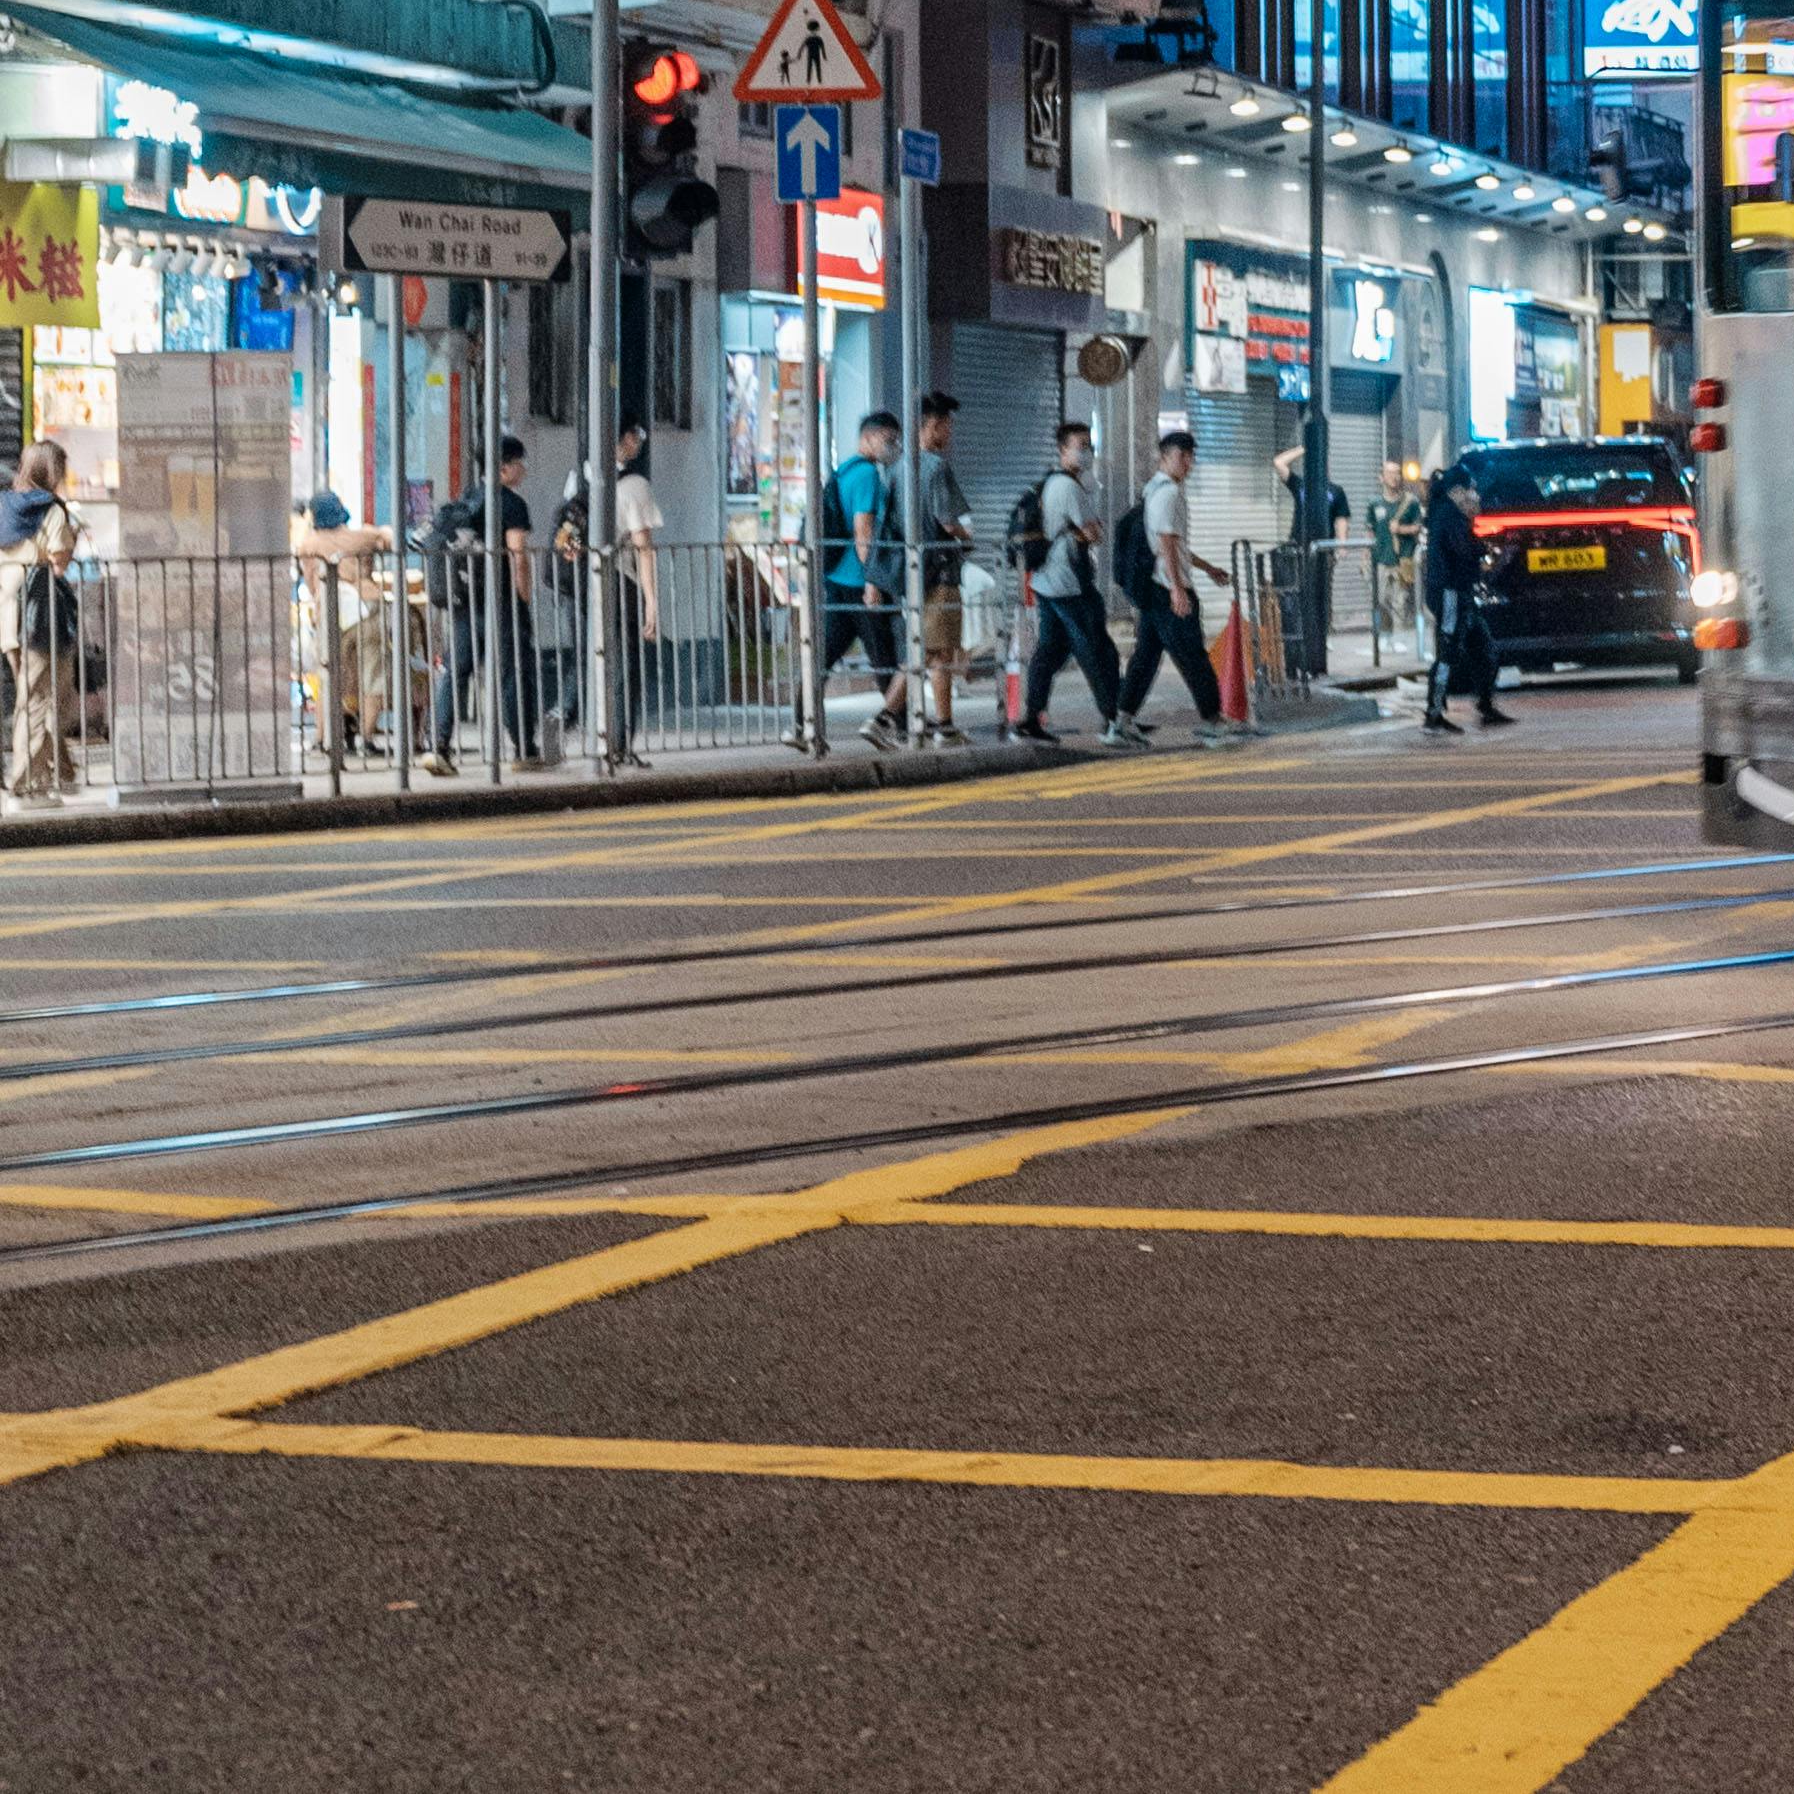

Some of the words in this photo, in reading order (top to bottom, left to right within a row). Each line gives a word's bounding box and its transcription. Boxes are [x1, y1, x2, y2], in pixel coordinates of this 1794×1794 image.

[399, 211, 432, 230] Wan
[439, 212, 474, 233] Chai
[482, 214, 521, 236] Road
[429, 239, 492, 269] 灣仔道
